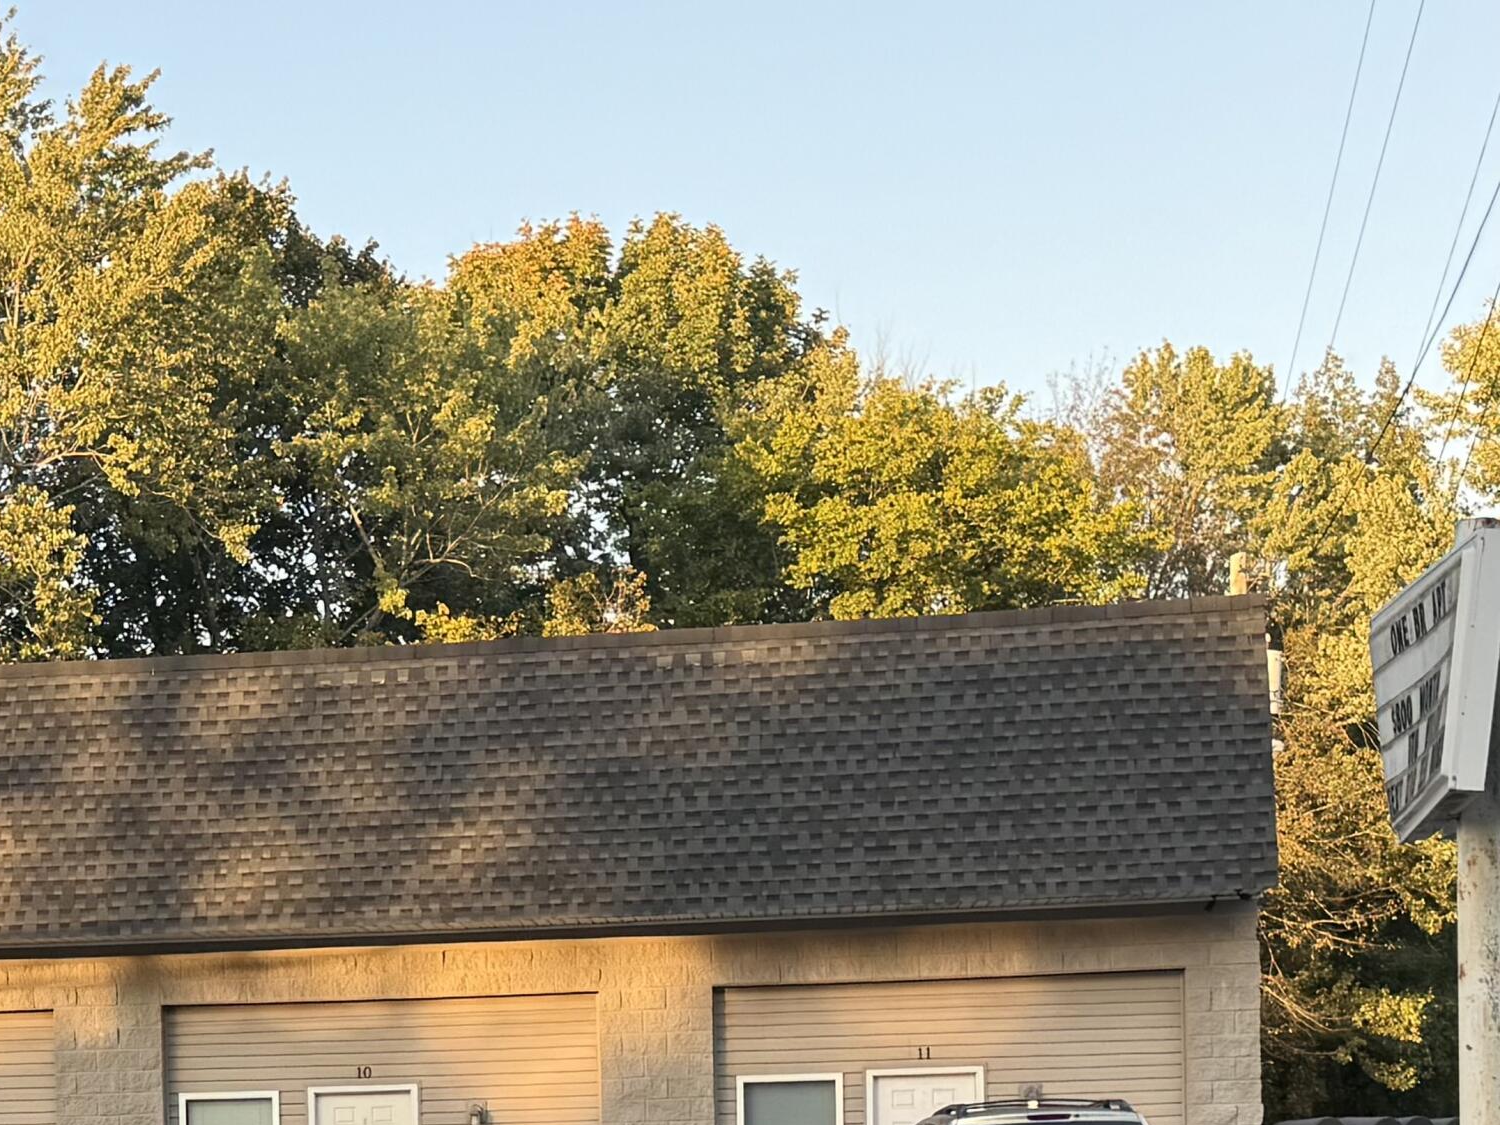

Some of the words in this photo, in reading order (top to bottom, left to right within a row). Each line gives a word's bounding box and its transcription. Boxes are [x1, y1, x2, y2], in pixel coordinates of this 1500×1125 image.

[1390, 615, 1410, 656] ONE
[1412, 602, 1427, 639] BR
[1432, 581, 1446, 625] APT
[918, 1047, 930, 1059] 11
[357, 1066, 372, 1078] 10
